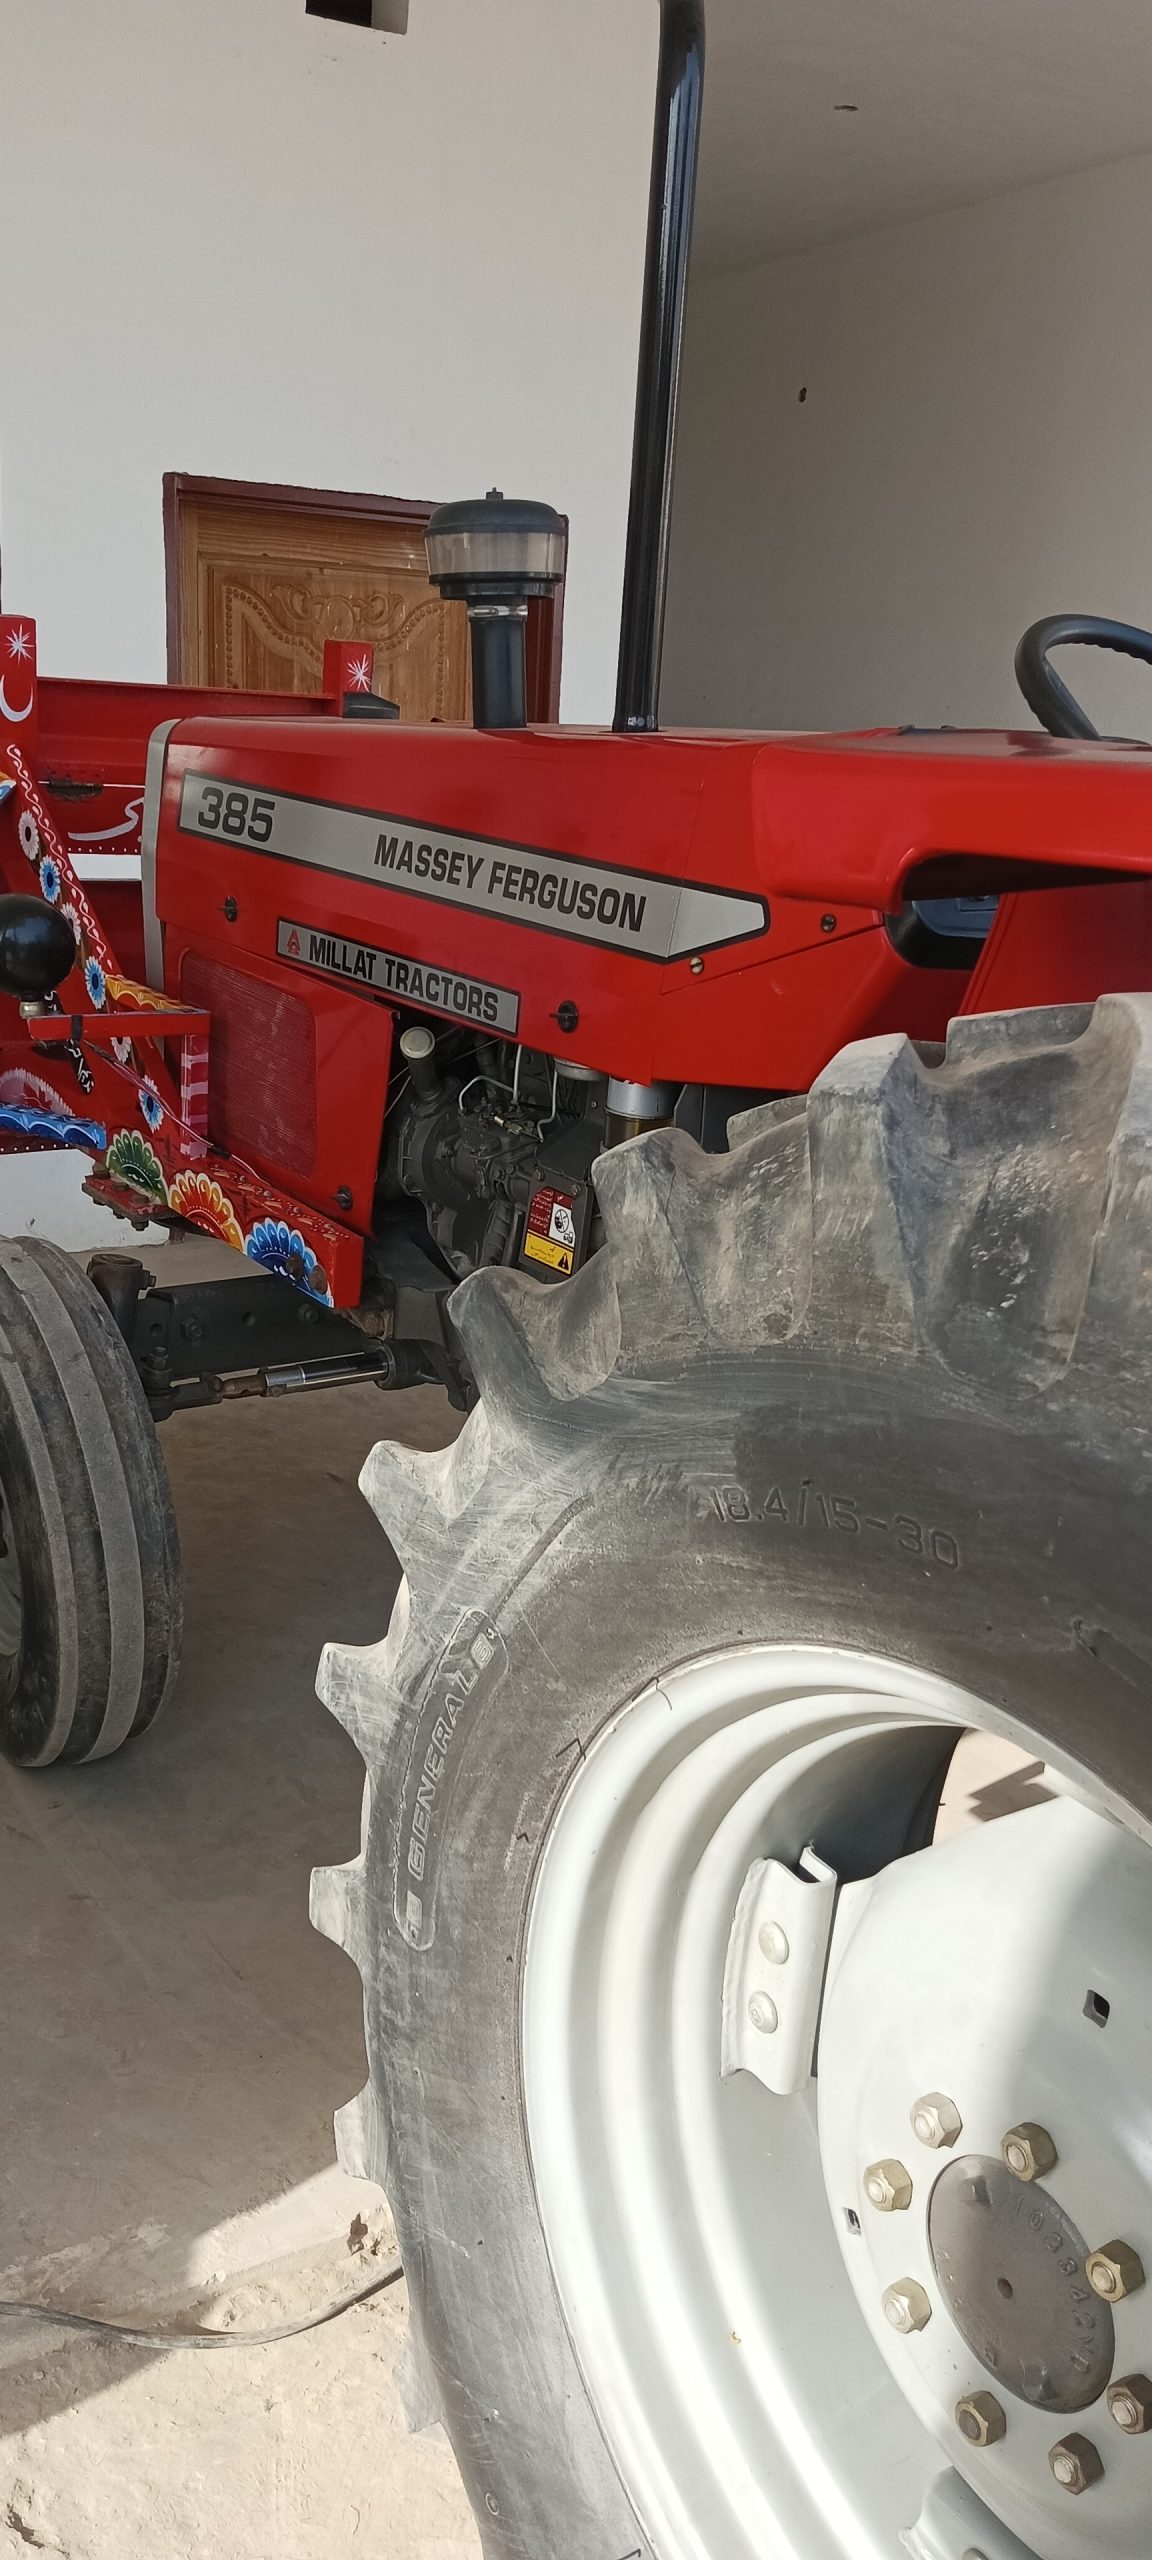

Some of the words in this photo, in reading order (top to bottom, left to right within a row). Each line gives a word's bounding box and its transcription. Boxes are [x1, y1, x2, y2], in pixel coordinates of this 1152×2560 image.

[197, 786, 276, 843] 385
[374, 834, 485, 887] MASSEY
[487, 861, 647, 933] FERGUSON
[308, 934, 375, 980] MILLAT
[384, 959, 499, 1022] TRACTORS
[709, 1485, 960, 1571] 18.4/15-30
[407, 1669, 479, 1881] GENERAL
